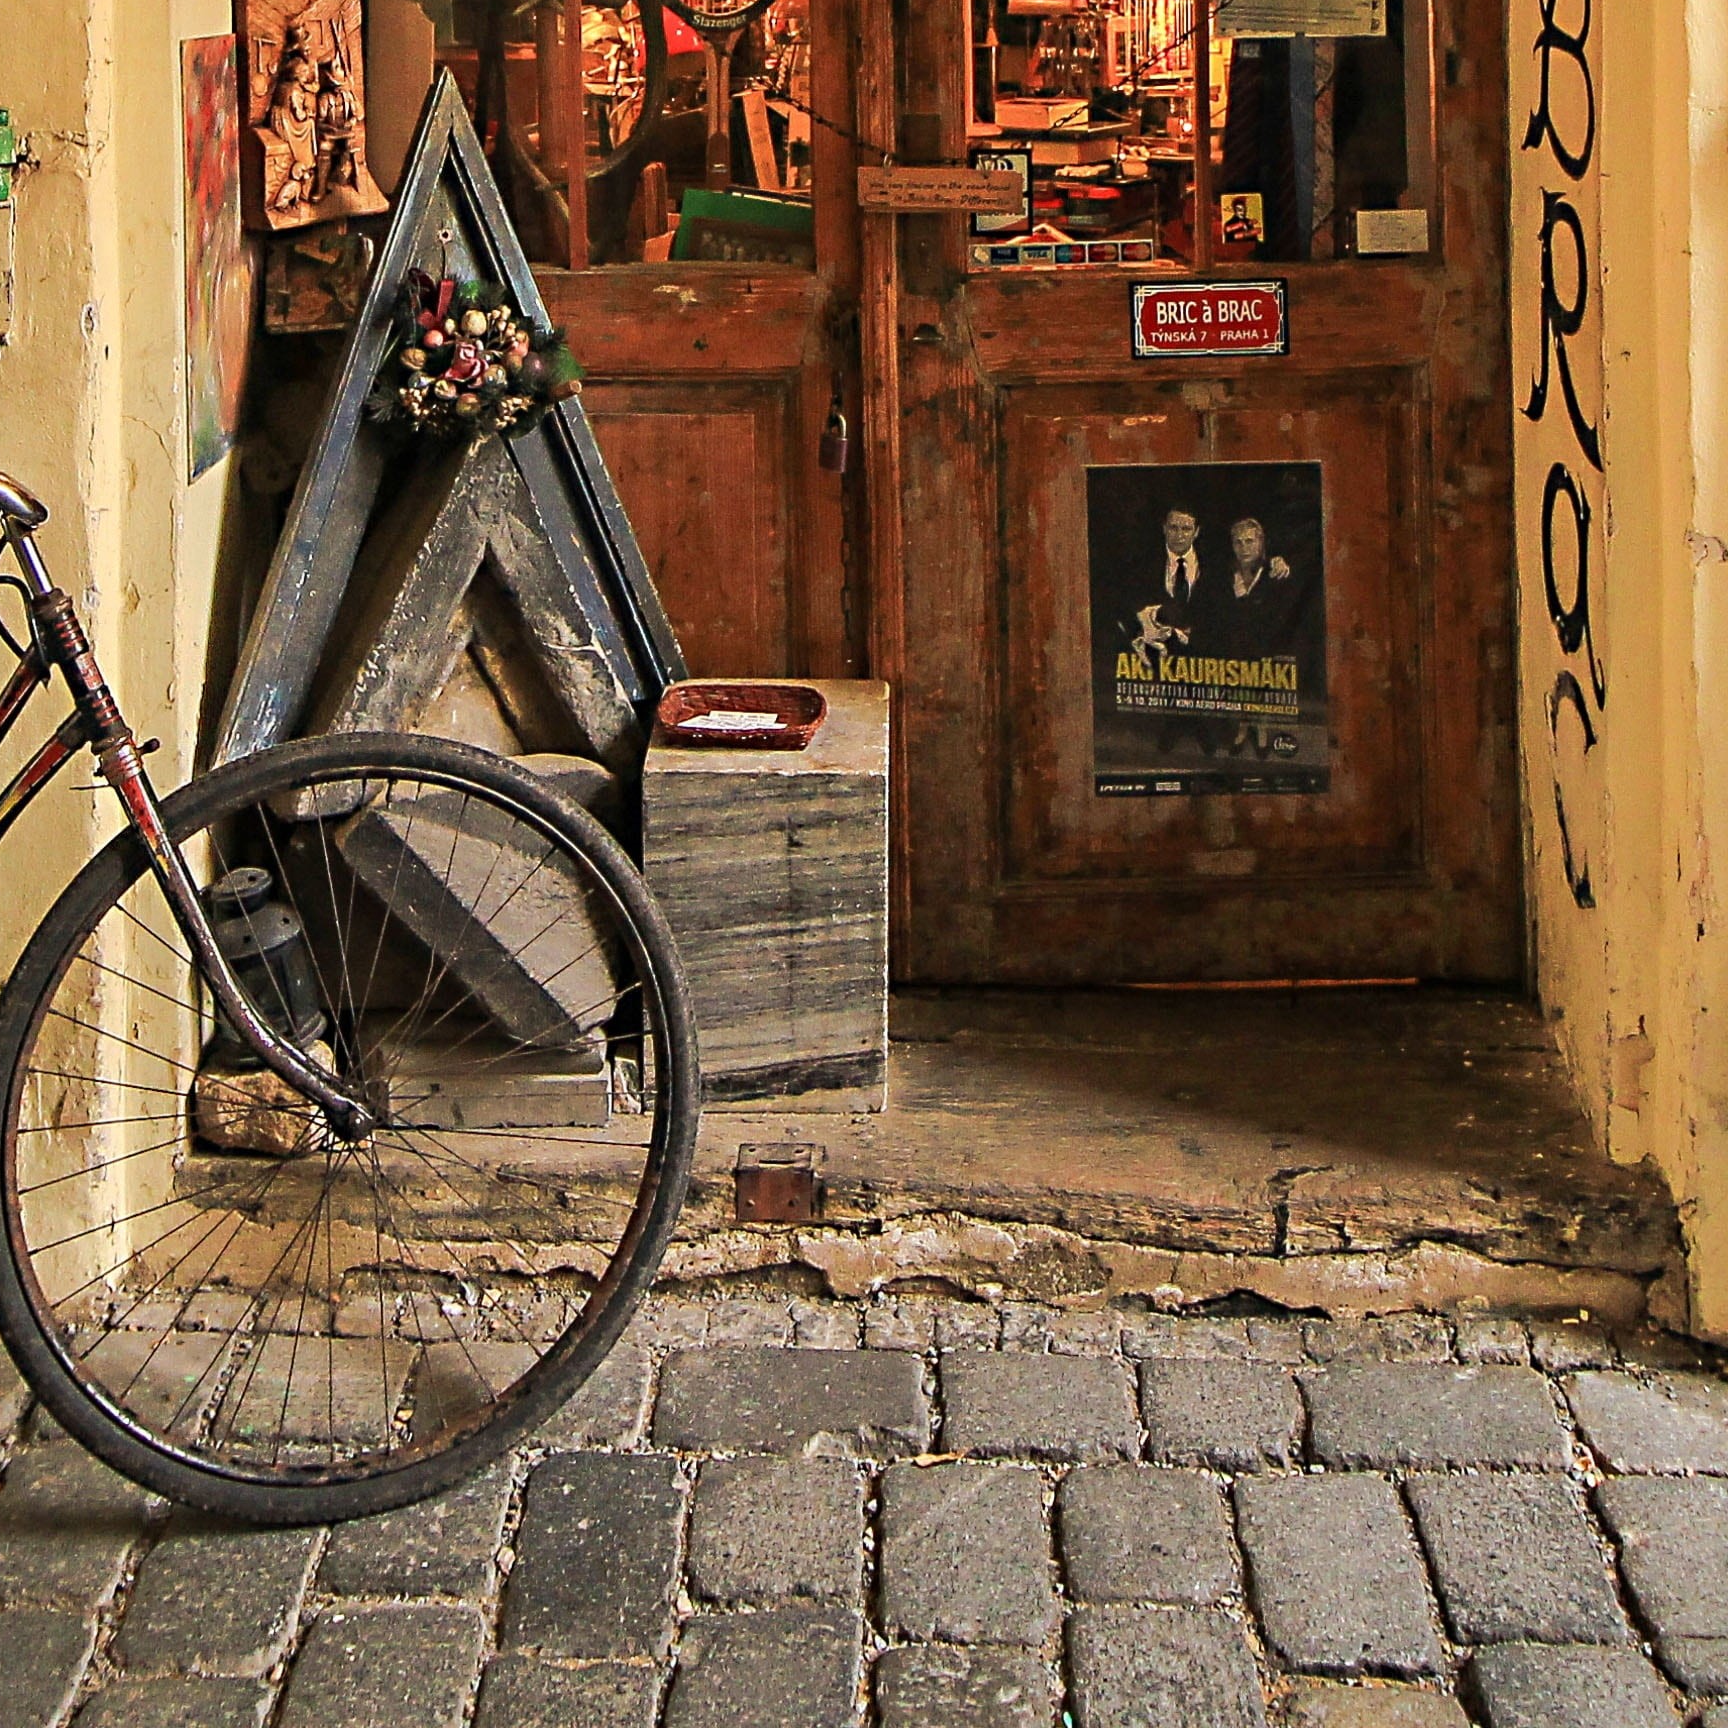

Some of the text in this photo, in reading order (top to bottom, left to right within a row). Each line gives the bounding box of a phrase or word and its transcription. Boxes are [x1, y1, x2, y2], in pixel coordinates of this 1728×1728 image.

[693, 14, 747, 28] Slazenger
[1156, 299, 1263, 325] BRIC à BRAC
[1150, 328, 1269, 343] TÝNSKÁ 7 PRAHA 1
[1159, 655, 1298, 691] KAURISMÄKI
